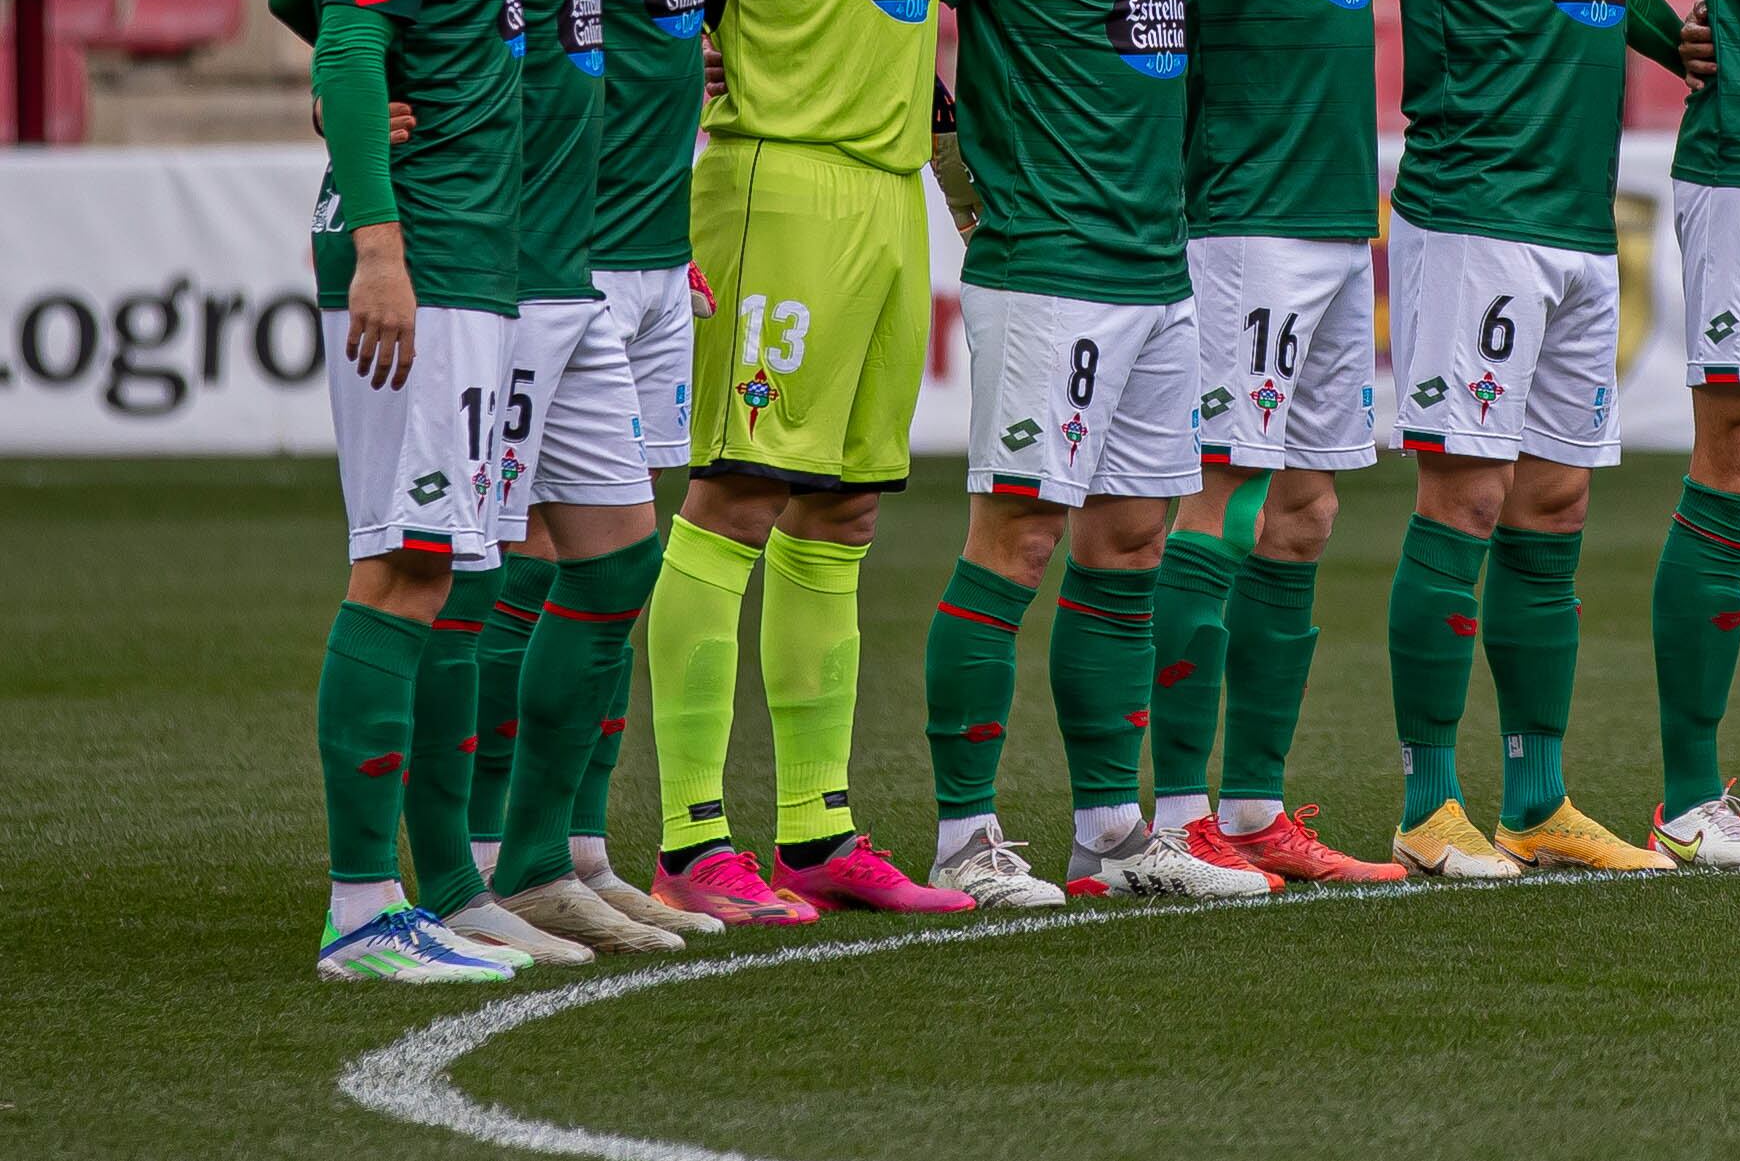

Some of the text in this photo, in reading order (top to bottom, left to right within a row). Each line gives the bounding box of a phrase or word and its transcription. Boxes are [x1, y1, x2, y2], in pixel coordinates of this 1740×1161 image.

[1131, 22, 1185, 50] Galicia
[1590, 0, 1608, 23] 0,0
[1155, 51, 1173, 73] 0,0
[0, 275, 326, 417] ogro
[740, 294, 810, 374] 13
[1244, 307, 1299, 380] 16
[1477, 295, 1516, 363] 6
[501, 368, 536, 443] 5
[1066, 337, 1100, 410] 8
